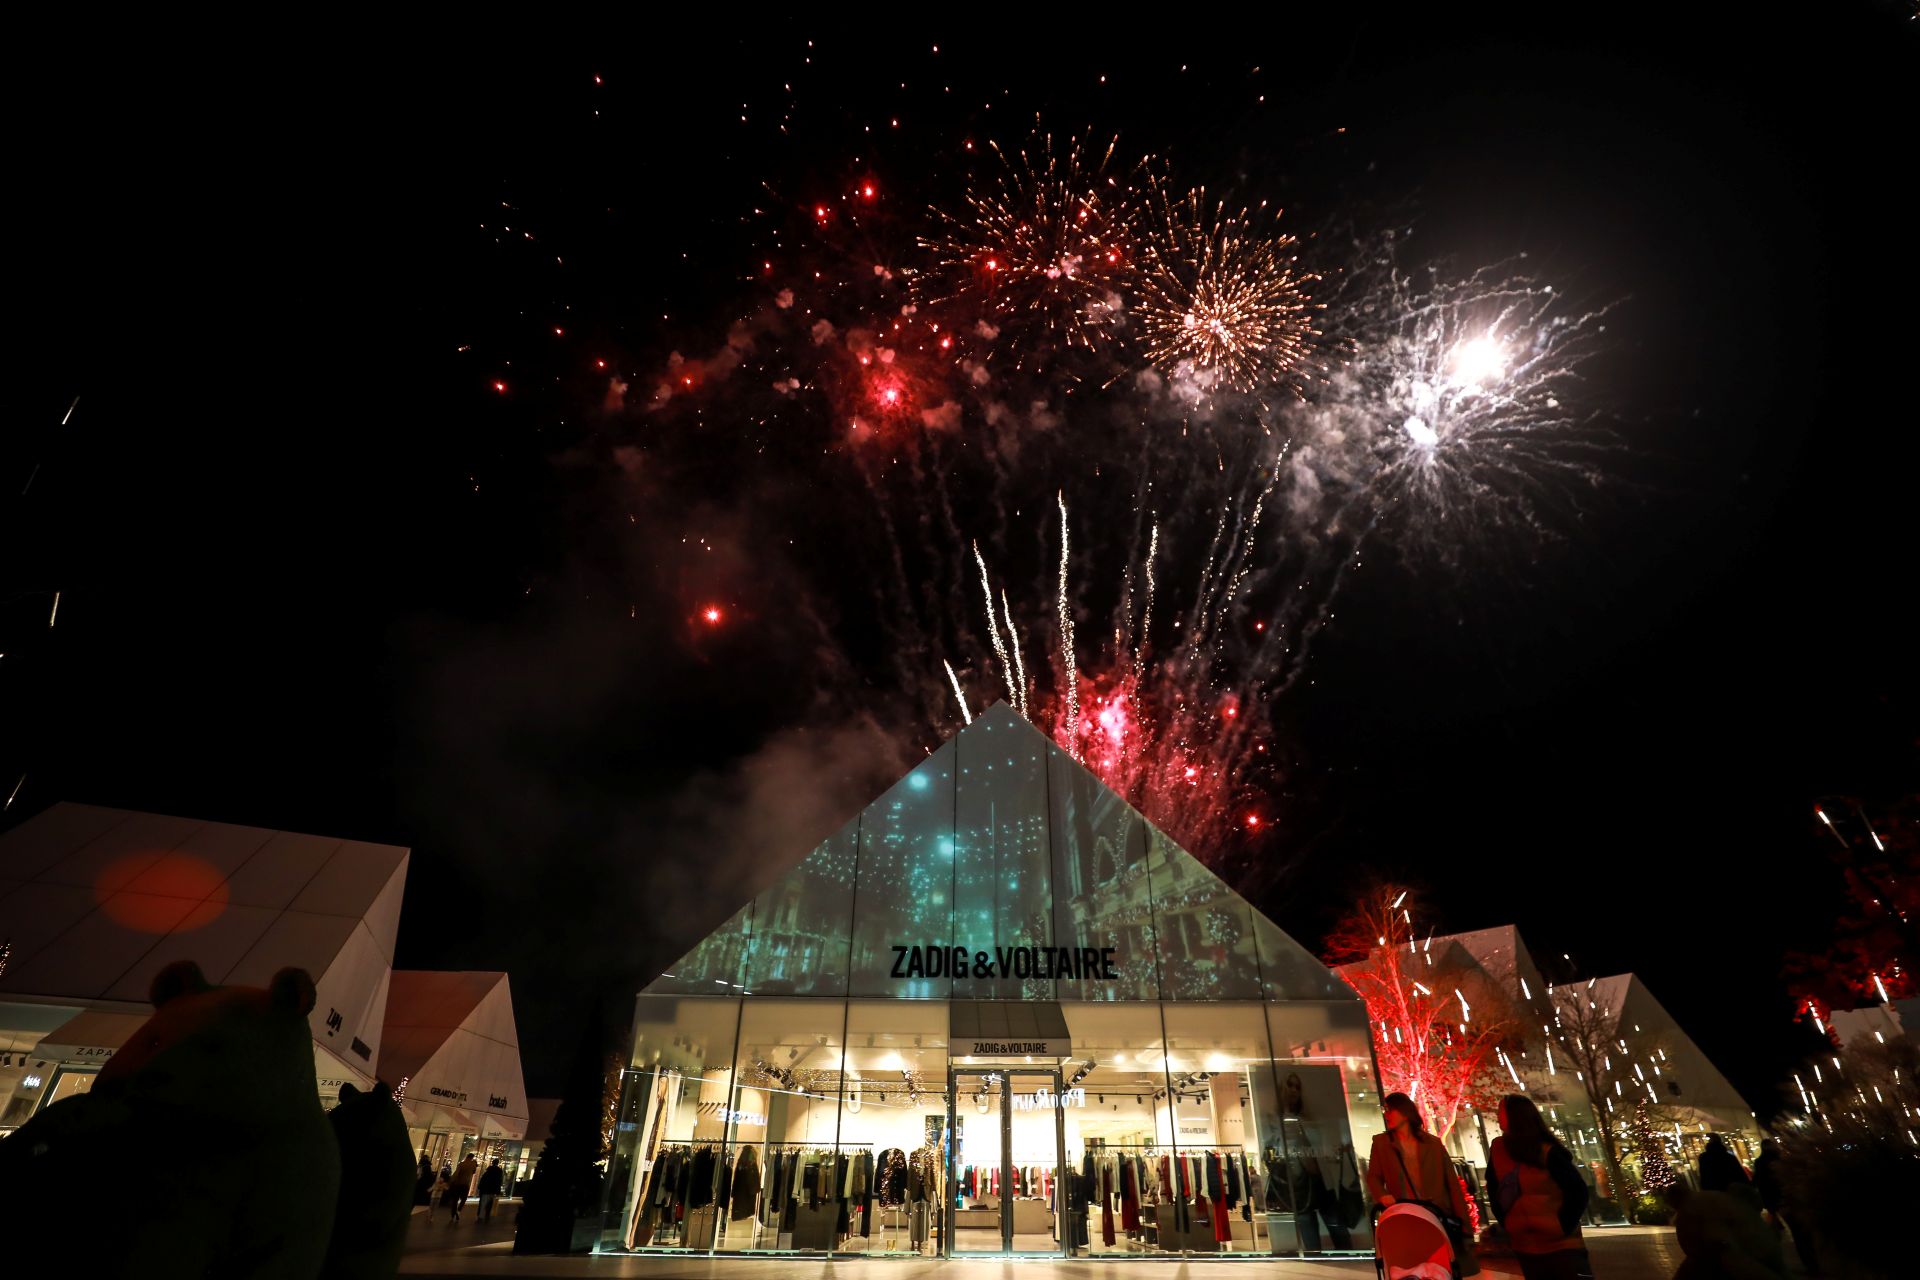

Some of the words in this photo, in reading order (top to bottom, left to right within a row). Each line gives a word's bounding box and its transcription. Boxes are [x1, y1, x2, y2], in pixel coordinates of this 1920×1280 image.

[75, 1047, 113, 1057] ZAPA
[973, 1042, 1048, 1054] ZADIG&VOLTAIRE
[320, 1079, 346, 1087] ZAP
